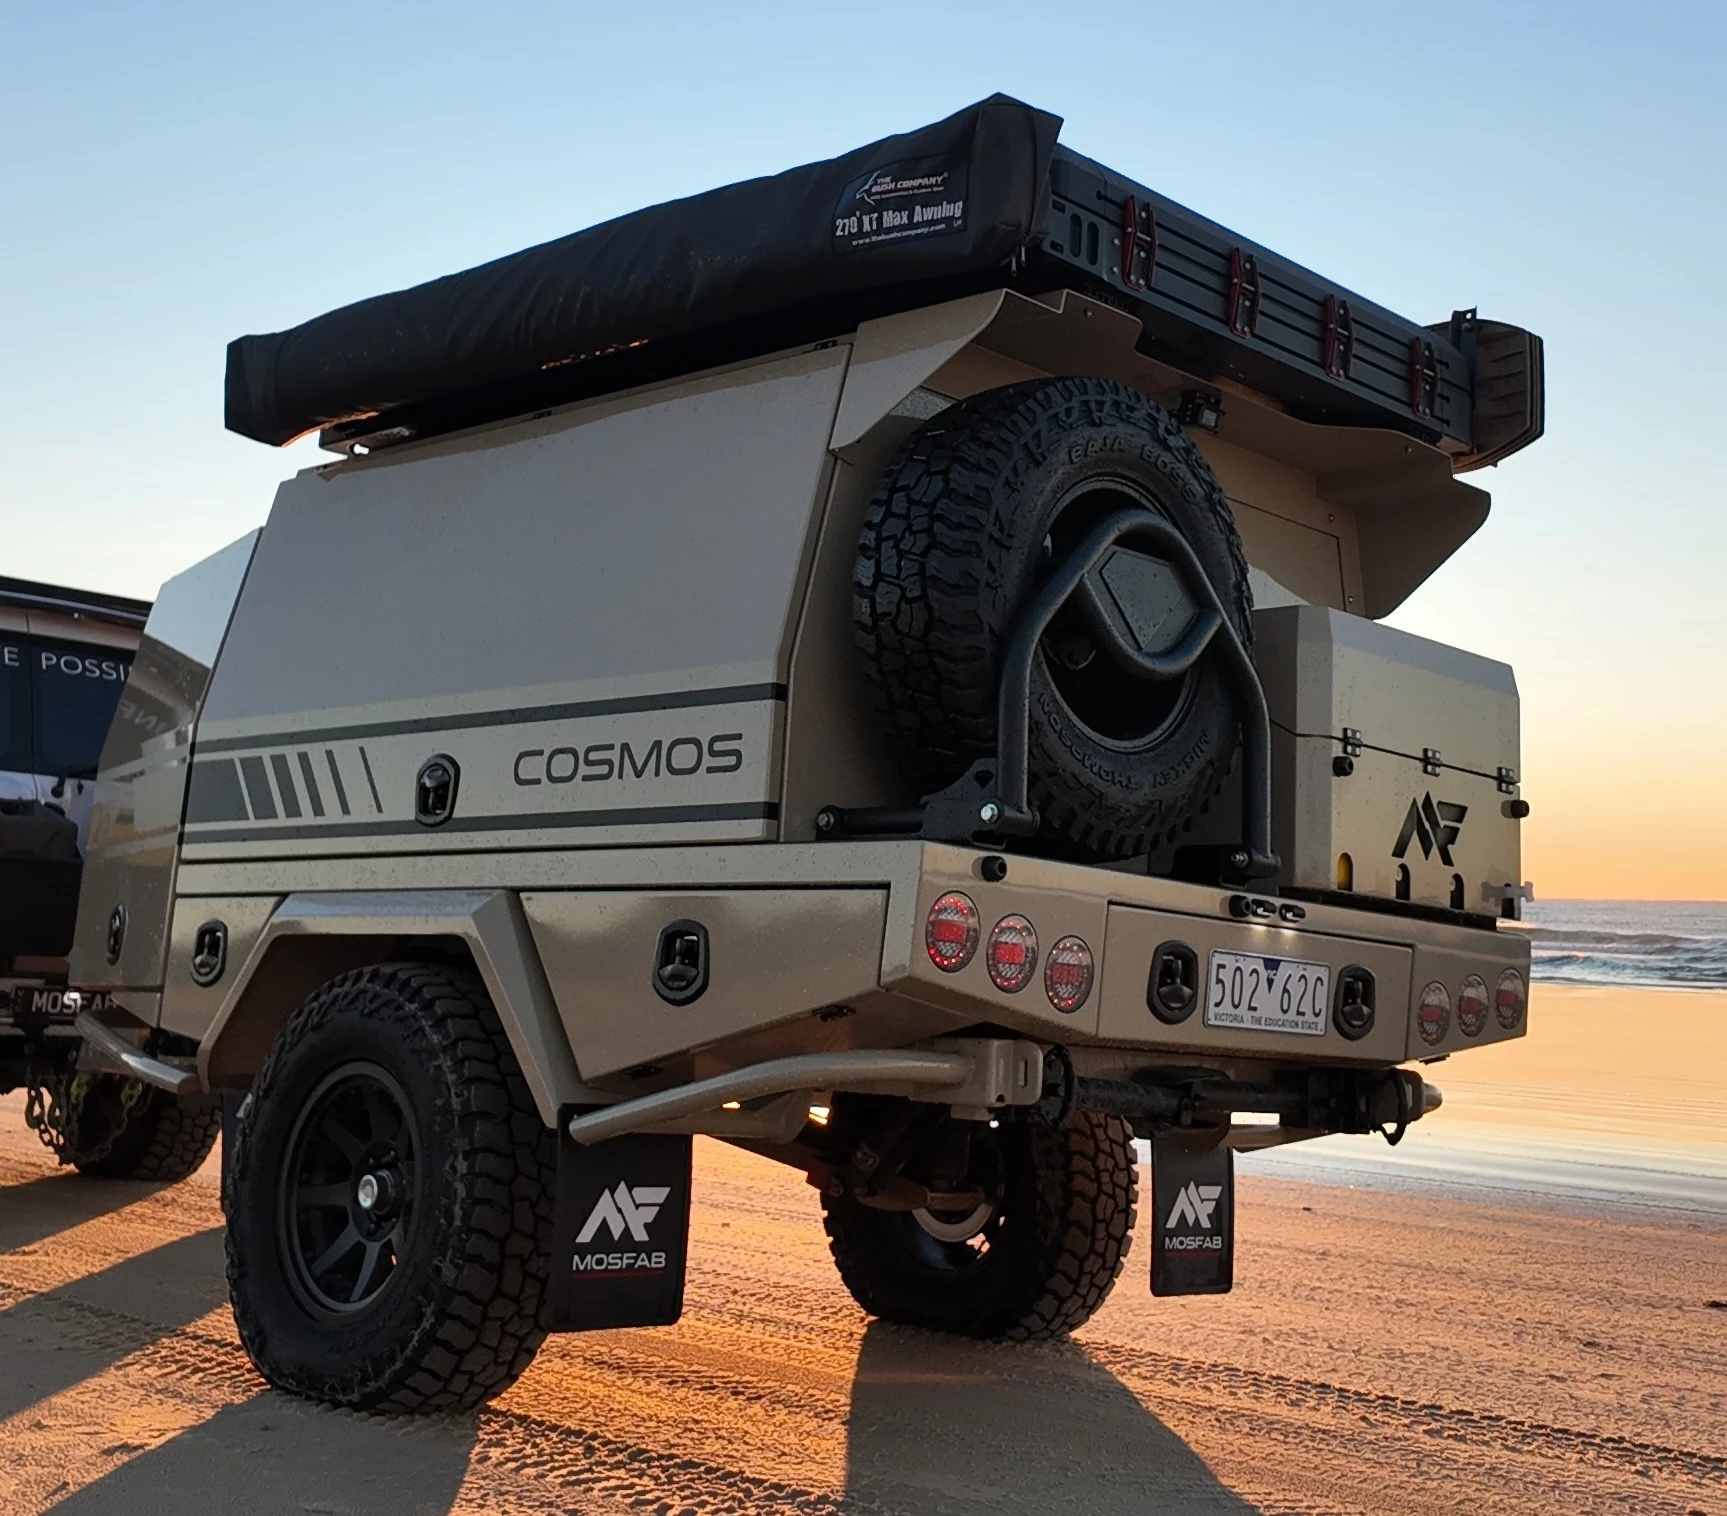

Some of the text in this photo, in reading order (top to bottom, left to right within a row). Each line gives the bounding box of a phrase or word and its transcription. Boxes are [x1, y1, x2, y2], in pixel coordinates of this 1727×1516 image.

[882, 210, 908, 228] Max
[914, 200, 963, 223] Awning
[41, 651, 132, 682] POSSI
[513, 732, 743, 786] COSMOS
[1213, 963, 1324, 1018] 502 62C
[1214, 1012, 1320, 1032] VICTORIA THE EDUCATION STATE
[1164, 1236, 1222, 1250] MOSFAB
[572, 1251, 666, 1271] MOSFAB
